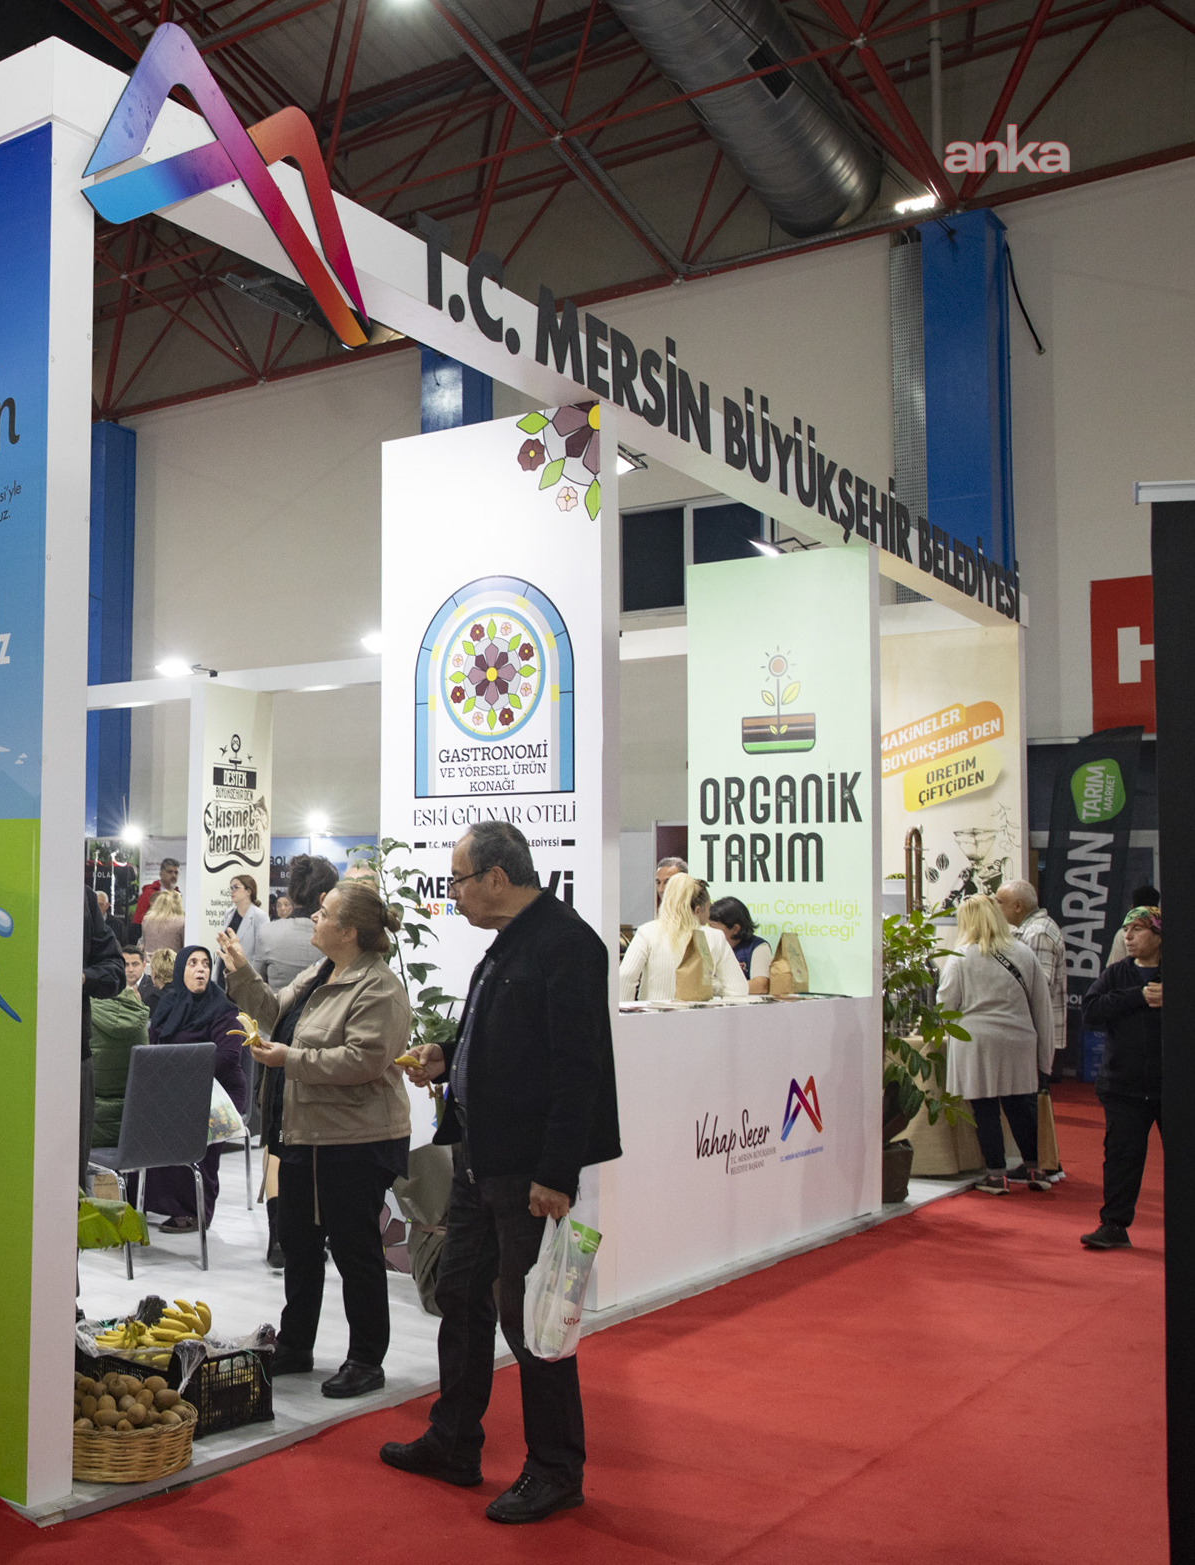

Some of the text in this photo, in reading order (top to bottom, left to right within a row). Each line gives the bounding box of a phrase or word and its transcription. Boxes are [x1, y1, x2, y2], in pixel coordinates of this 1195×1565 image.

[416, 209, 1020, 623] T.C. MERSİN BÜYÜKŞEHİR BELEDİYESİ
[438, 739, 548, 763] GASTRONOMİ
[439, 761, 547, 778] VE YÖRESEL ÜRÜN
[469, 777, 515, 792] KONAĞI
[1081, 766, 1106, 820] TARIM
[1103, 774, 1116, 812] MARKET
[413, 805, 448, 826] ESKİ
[526, 800, 576, 824] OTELİ
[209, 829, 260, 853] denizden
[700, 832, 824, 883] TARIM
[1061, 830, 1114, 979] BARAN
[696, 1109, 770, 1174] Vahap Seçer
